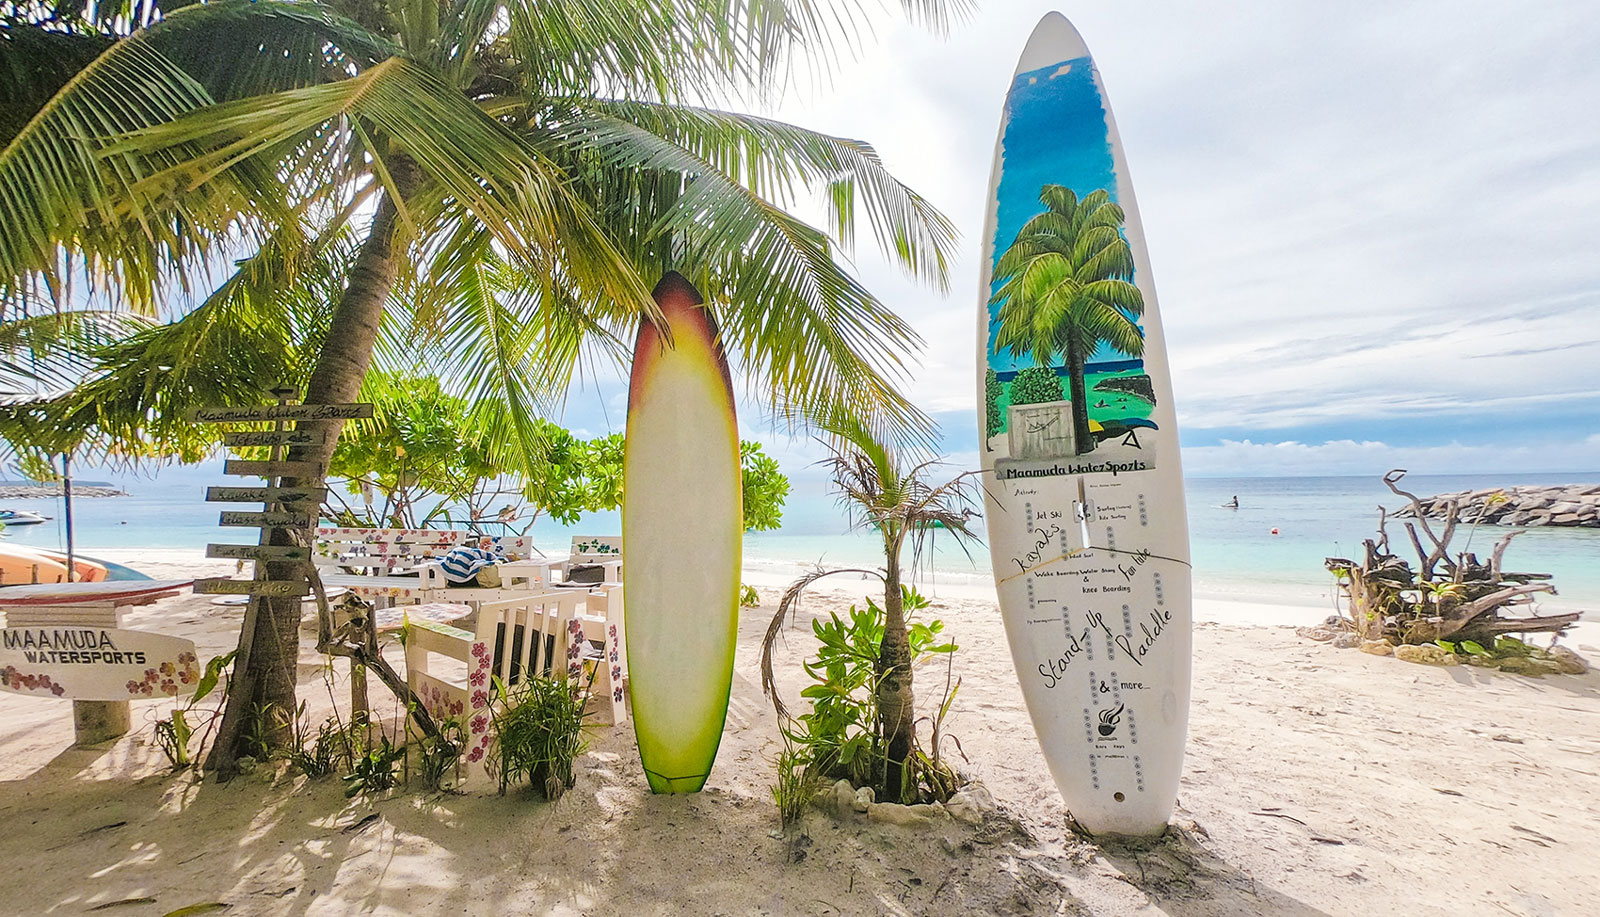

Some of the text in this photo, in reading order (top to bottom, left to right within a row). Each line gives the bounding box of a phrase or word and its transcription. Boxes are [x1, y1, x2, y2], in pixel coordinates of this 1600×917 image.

[1006, 464, 1066, 479] Maamuda
[1036, 511, 1063, 520] Jet Ski
[1102, 585, 1131, 593] Boarding
[3, 629, 118, 651] MAAMUDA
[1115, 608, 1172, 666] Paddle
[24, 650, 147, 665] WATERSPORTS
[1099, 680, 1111, 694] &
